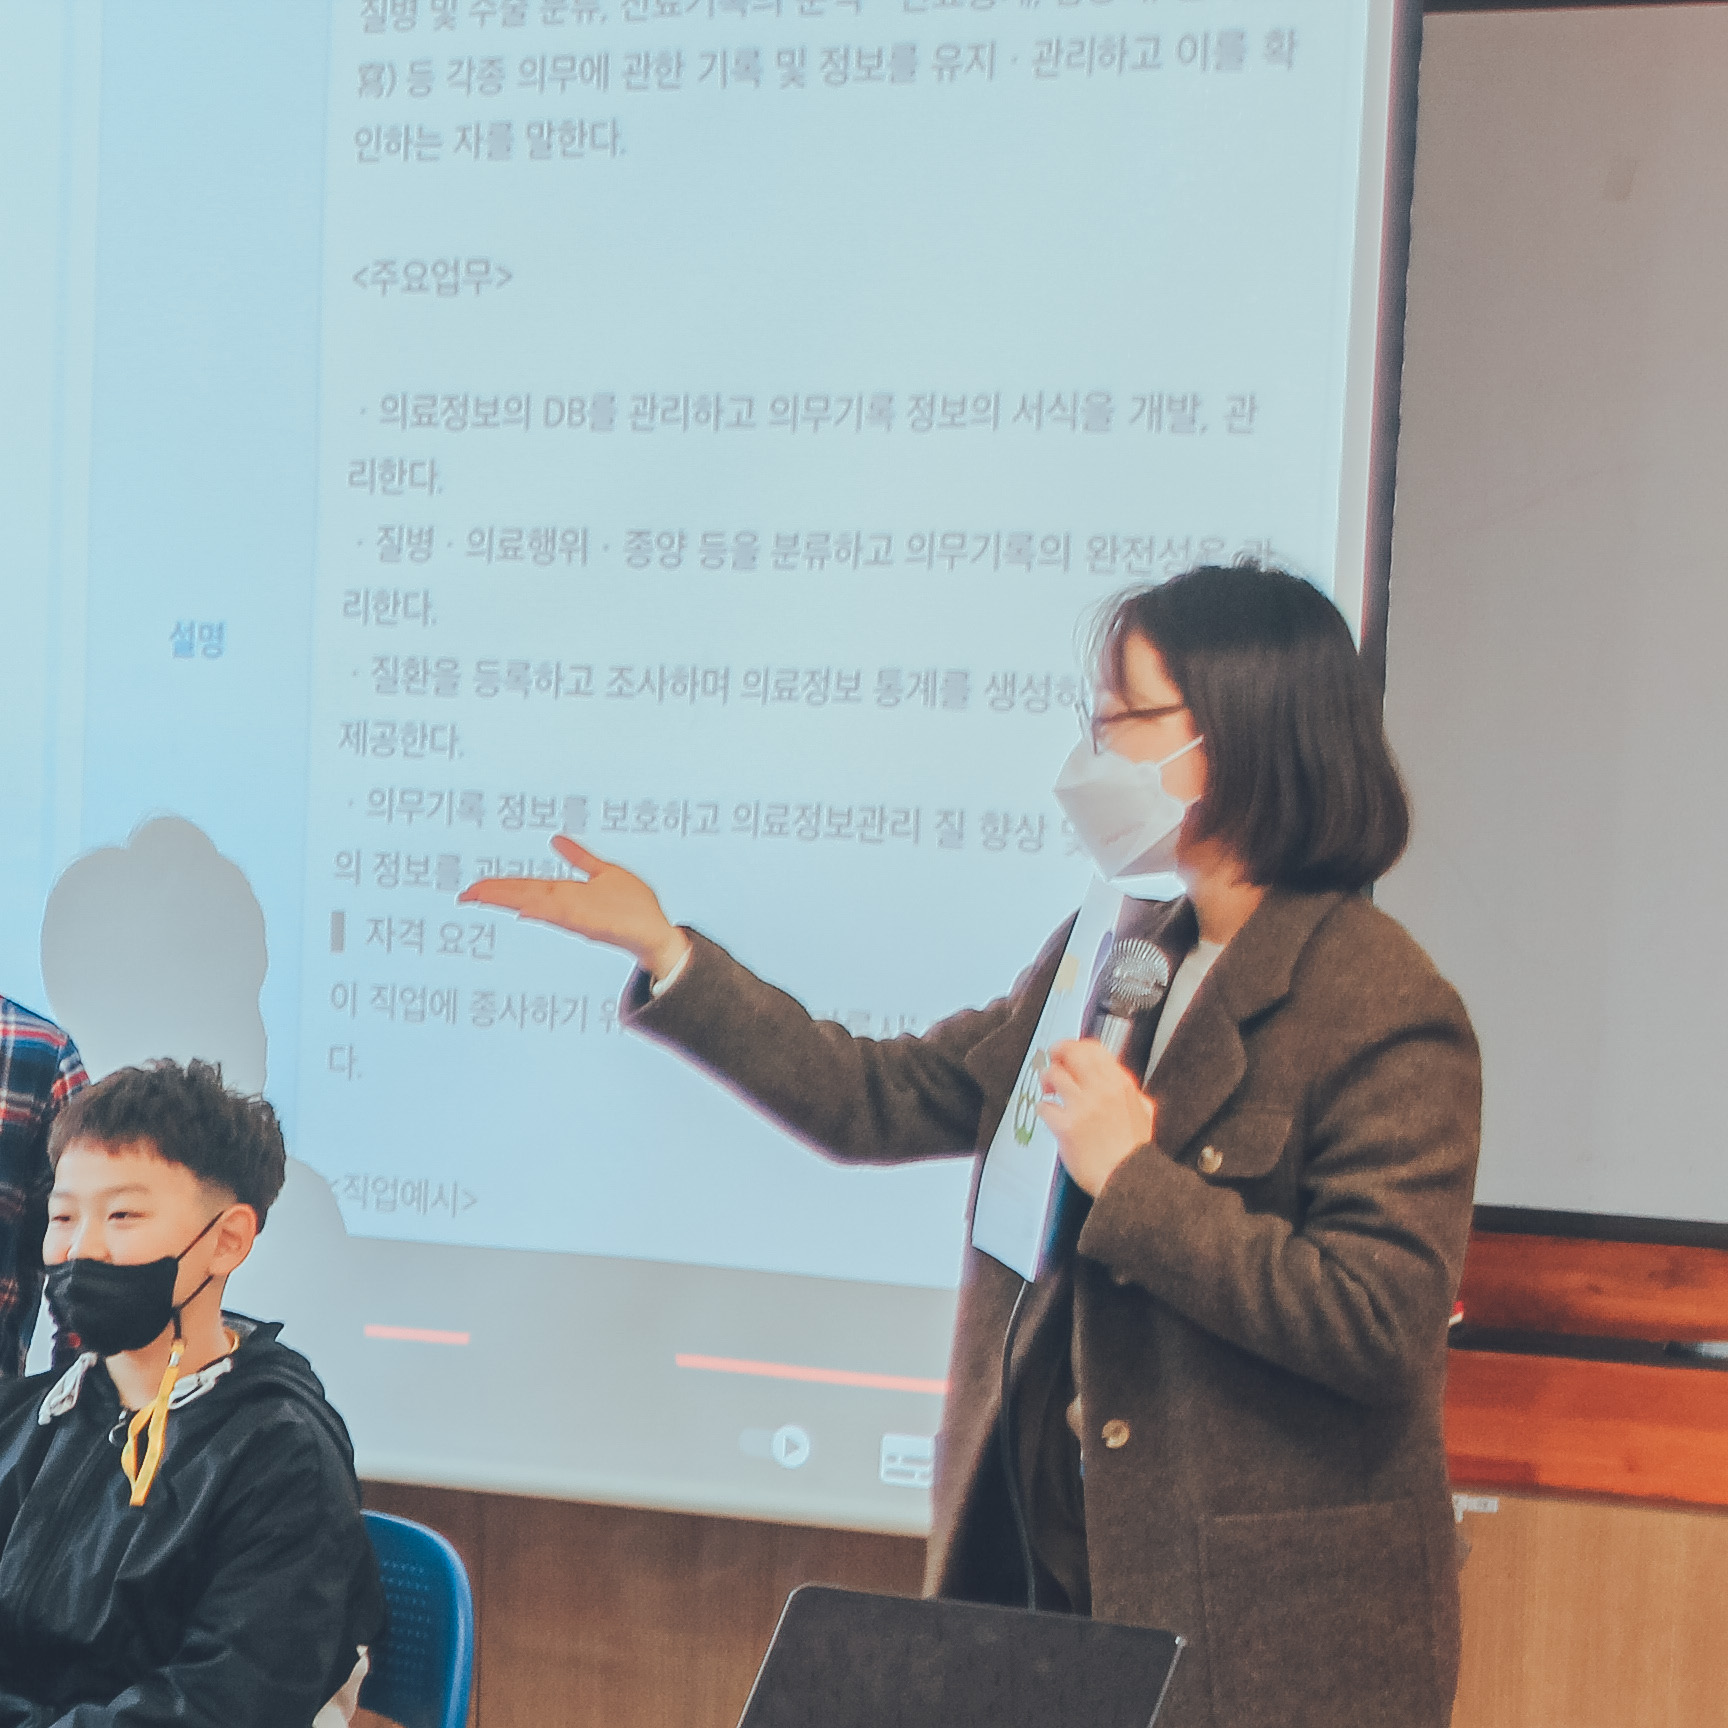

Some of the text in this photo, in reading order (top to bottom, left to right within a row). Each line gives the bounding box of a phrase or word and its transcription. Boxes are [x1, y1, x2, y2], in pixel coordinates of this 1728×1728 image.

[407, 58, 434, 98] 등
[447, 55, 504, 96] 각종
[518, 52, 609, 93] 의무에
[623, 51, 682, 90] 관한
[698, 48, 761, 89] 기록
[777, 48, 805, 88] 및
[820, 40, 917, 84] 정보를
[931, 41, 996, 82] 유지
[1031, 34, 1163, 79] 관리하고
[1176, 29, 1246, 73] 이를
[355, 118, 626, 163] 인하는 자를 말한다.
[352, 258, 513, 297] <주요업무>
[379, 393, 531, 431] 의료정보의
[544, 394, 615, 431] DB를
[629, 393, 756, 432] 관리하고
[769, 394, 894, 432] 의무기록
[907, 393, 999, 432] 정보의
[1012, 392, 1114, 432] 서식을
[1225, 392, 1259, 435] 관
[376, 525, 434, 563] 질병
[466, 527, 589, 566] 의료행위
[623, 530, 686, 569] 종양
[698, 530, 759, 570] 등을
[772, 531, 893, 570] 분류하고
[905, 531, 1072, 572] 의무기록의
[170, 620, 227, 659] 설명
[372, 656, 461, 696] 질환을
[474, 659, 594, 699] 등록하고
[606, 665, 729, 704] 조사하며
[742, 667, 862, 706] 의료정보
[875, 669, 970, 709] 통계를
[366, 786, 483, 827] 의무기록
[497, 794, 587, 833] 정보를
[601, 800, 720, 837] 보호하고
[732, 800, 920, 843] 의료정보관리
[935, 808, 965, 848] 질
[980, 810, 1046, 852] 향상
[334, 850, 361, 888] 의
[372, 851, 461, 890] 정보를
[366, 918, 495, 961] 자격 요건
[331, 983, 358, 1017] 이
[371, 984, 458, 1022] 직업에
[470, 990, 588, 1032] 종사하기
